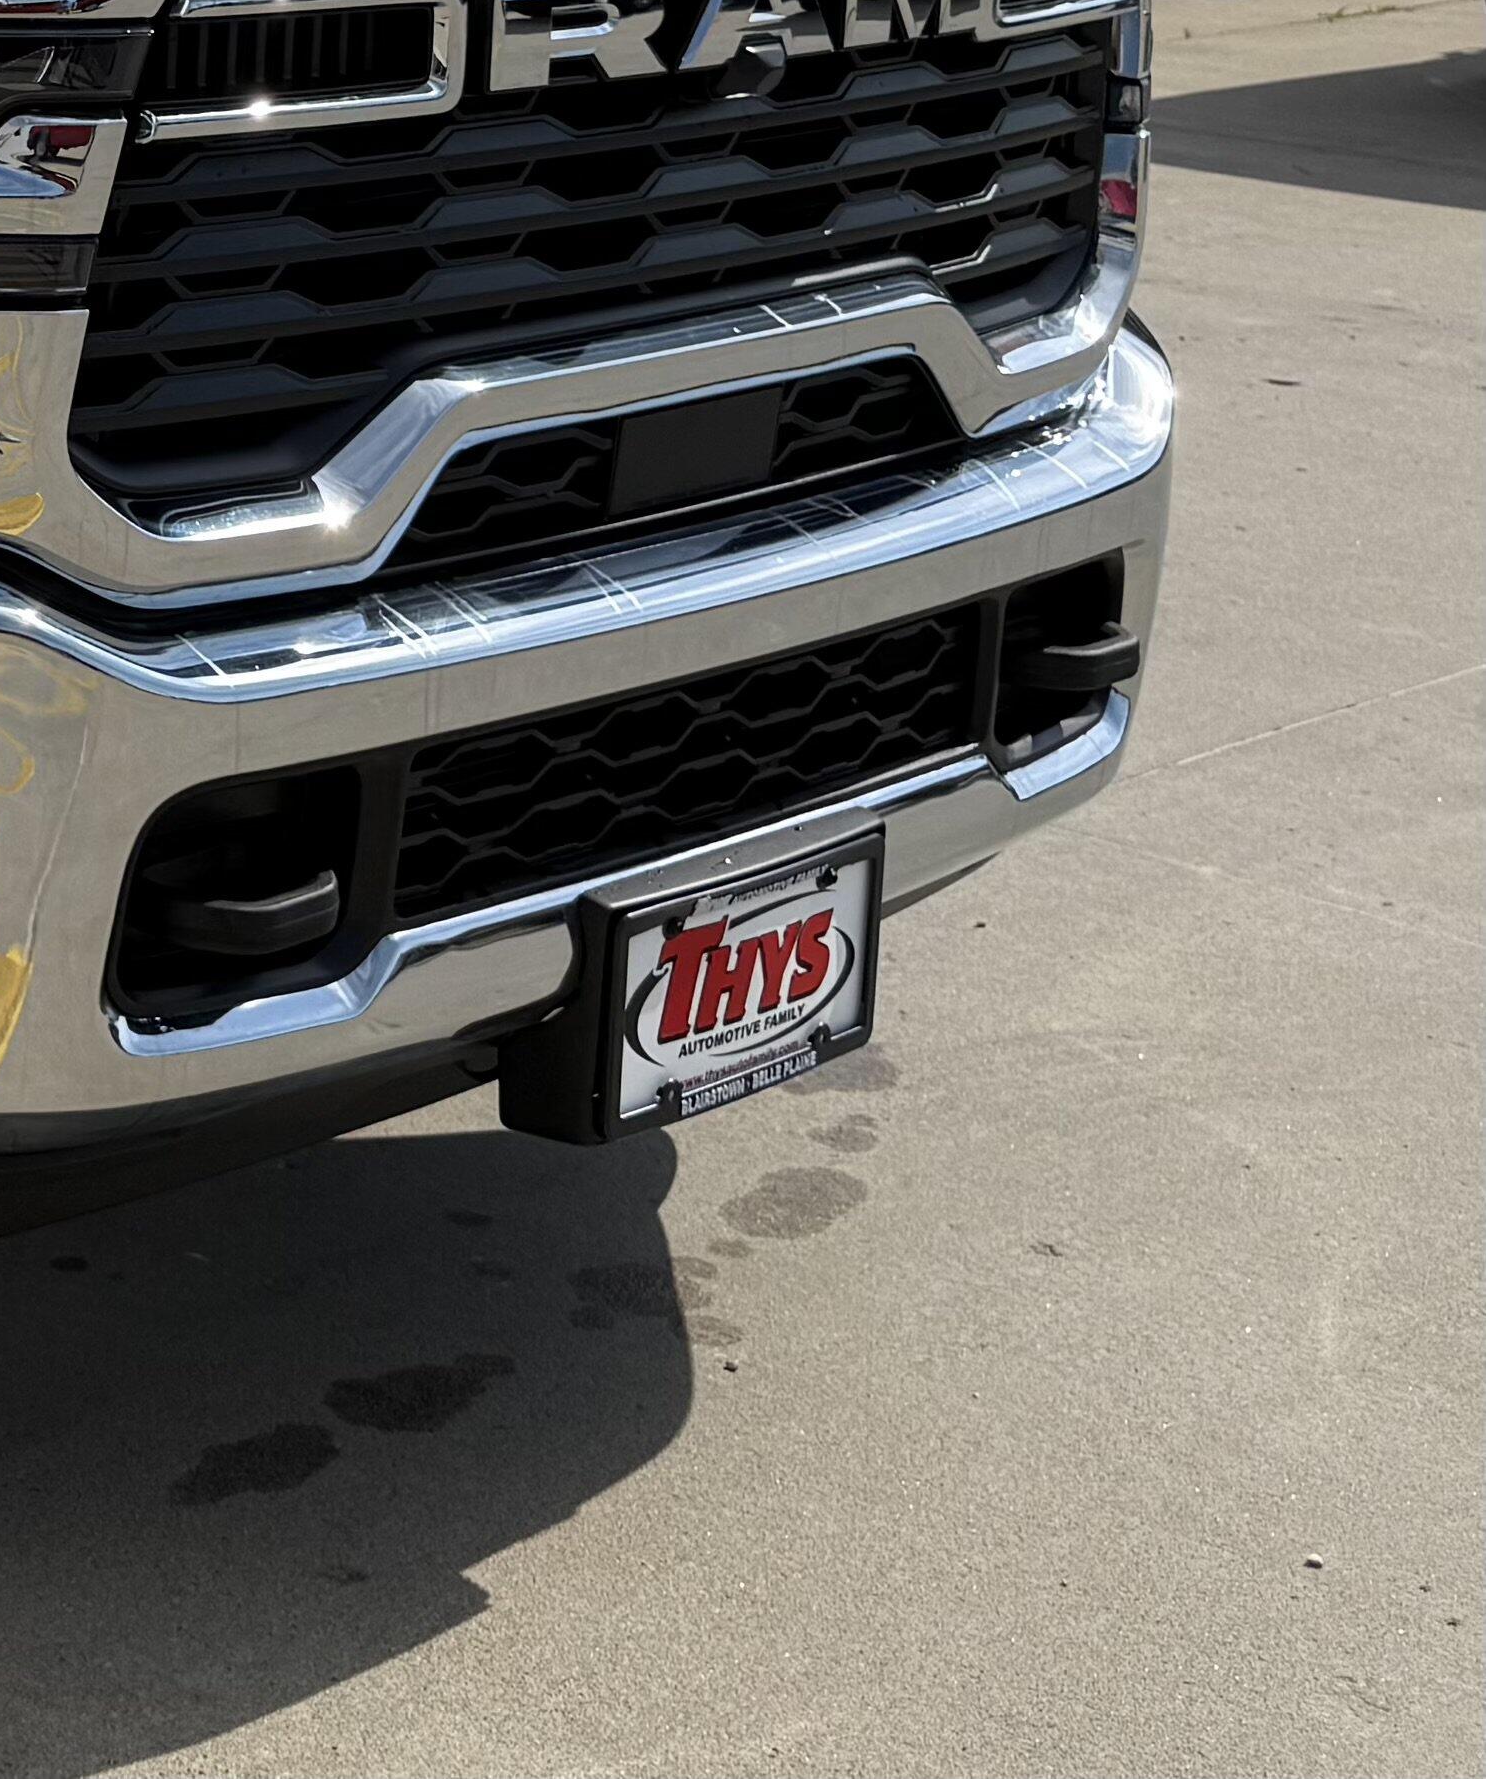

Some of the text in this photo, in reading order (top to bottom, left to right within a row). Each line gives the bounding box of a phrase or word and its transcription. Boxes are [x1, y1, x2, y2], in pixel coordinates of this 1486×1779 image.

[657, 907, 834, 1045] THYS
[678, 1003, 805, 1059] AUTOMOTIVE FAMILY
[681, 1077, 746, 1117] BLAIRSTOWN
[783, 1050, 818, 1079] PLAINE
